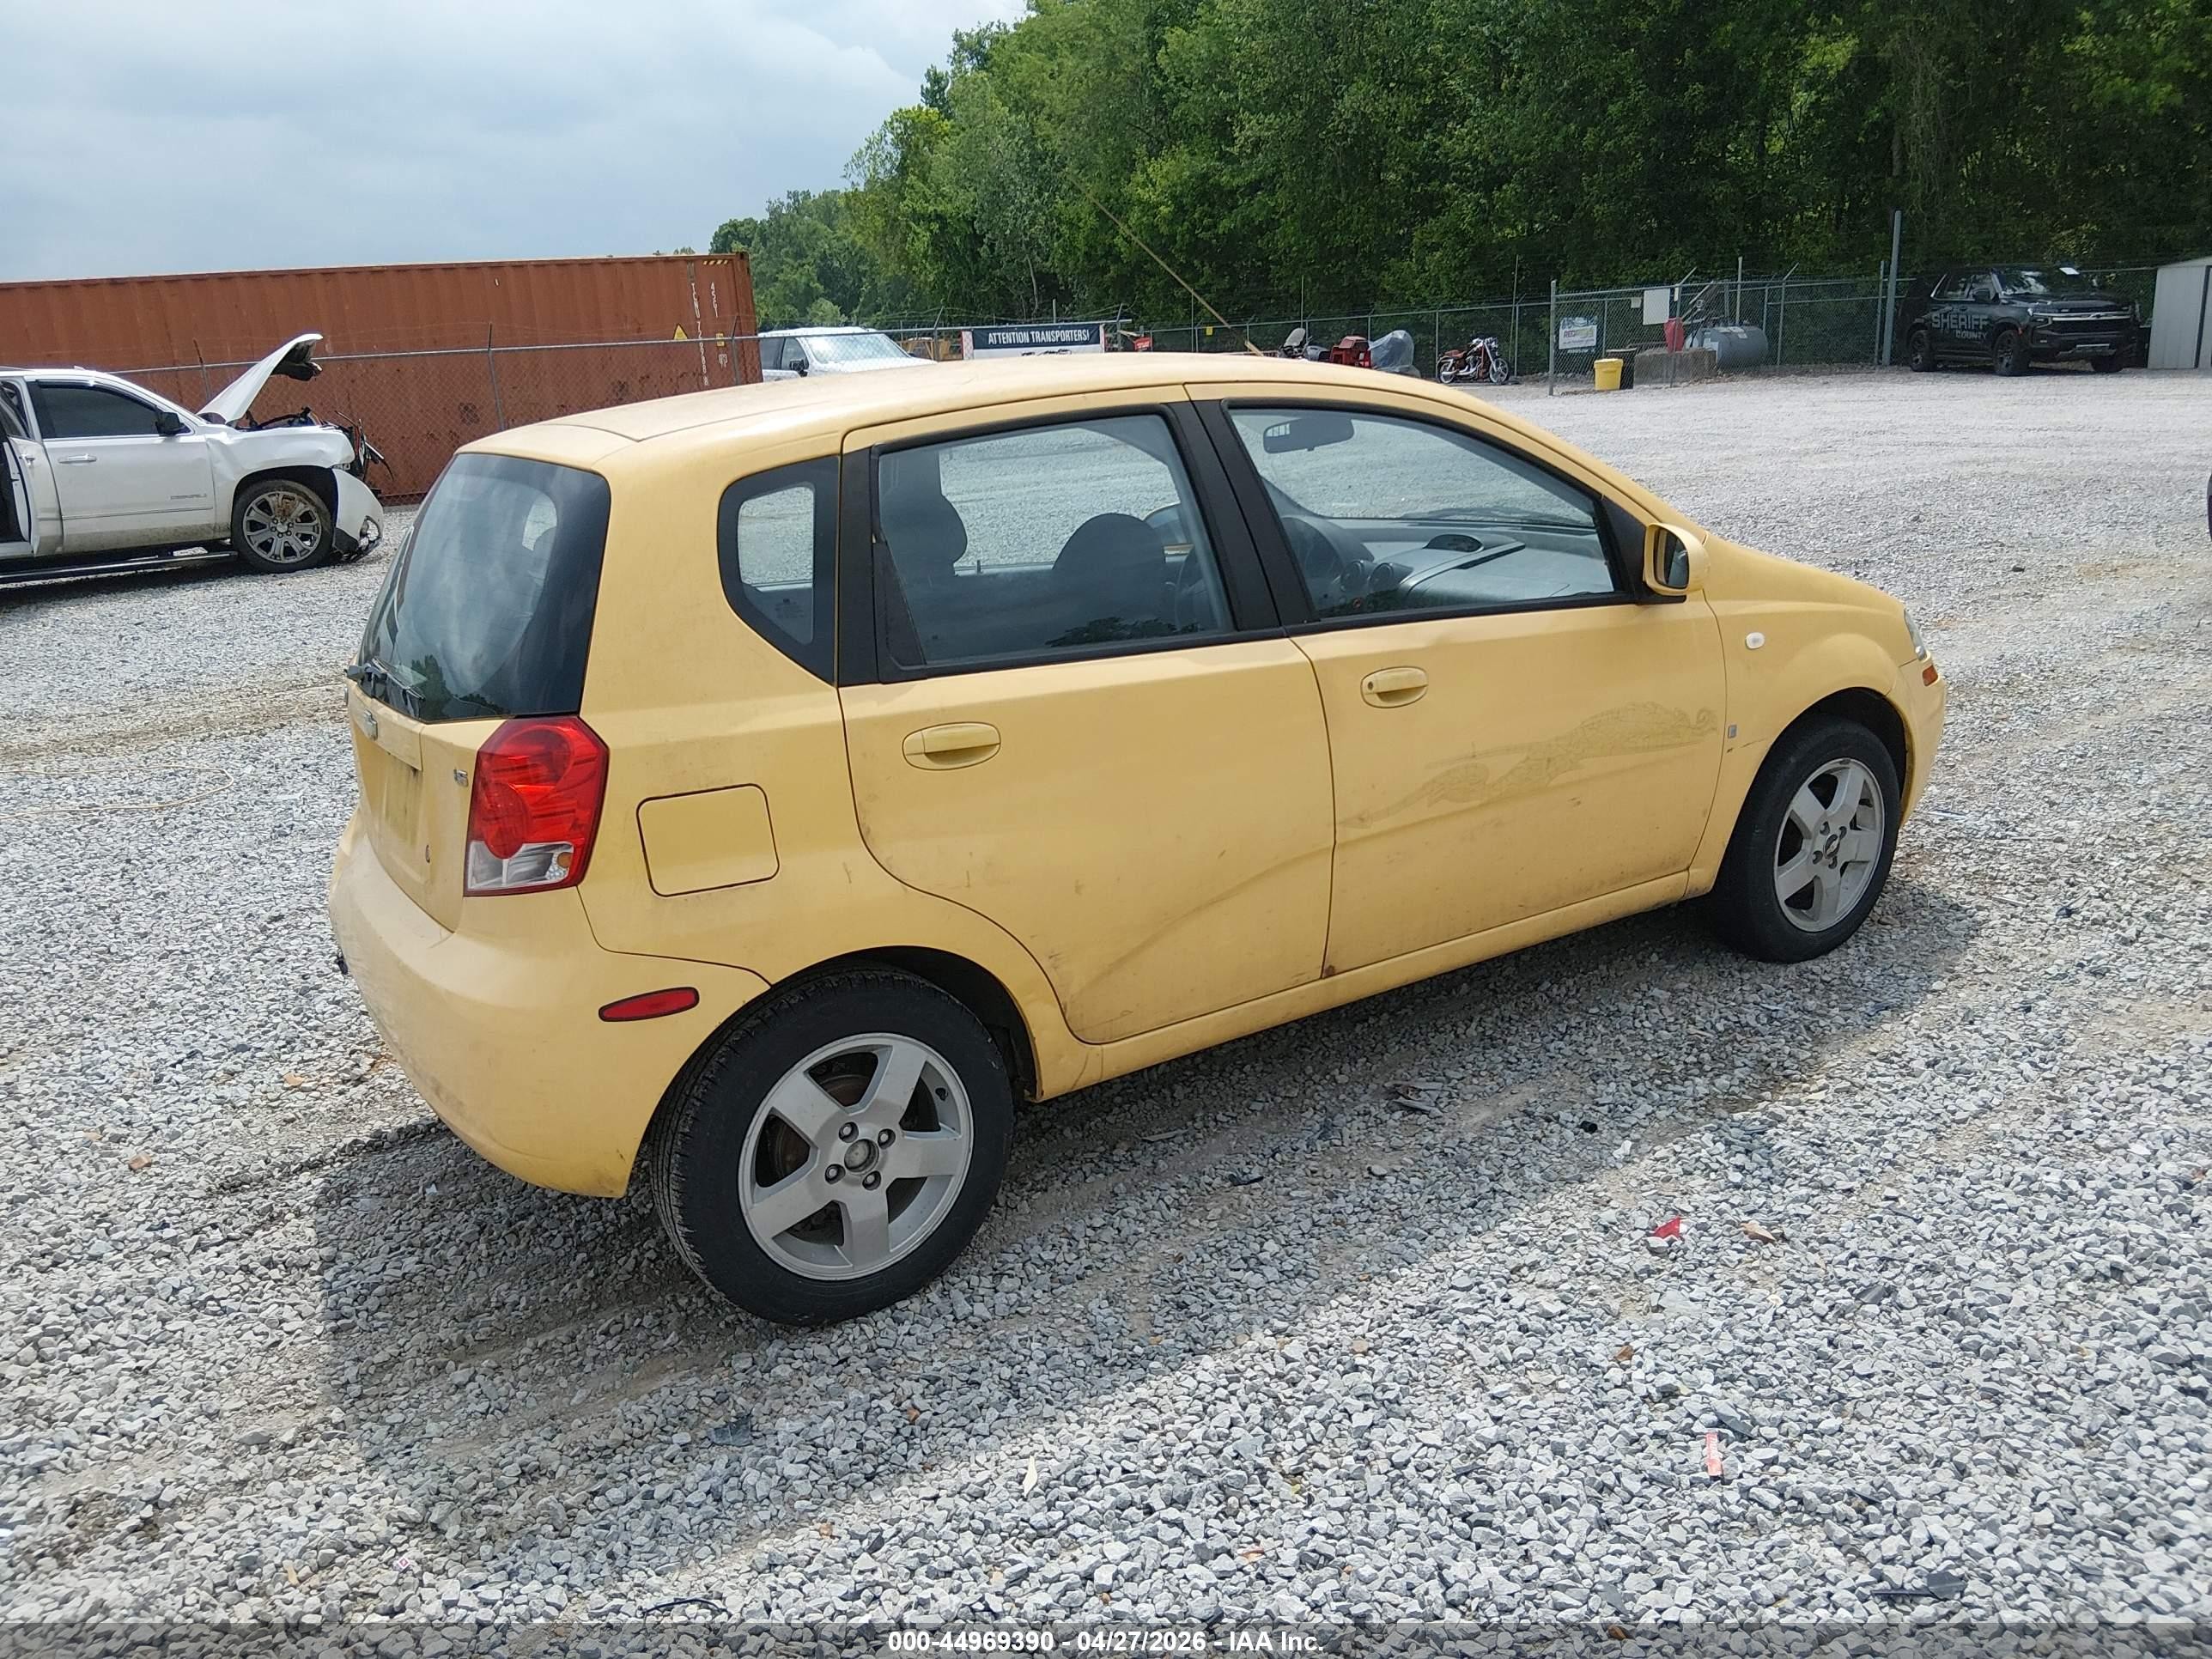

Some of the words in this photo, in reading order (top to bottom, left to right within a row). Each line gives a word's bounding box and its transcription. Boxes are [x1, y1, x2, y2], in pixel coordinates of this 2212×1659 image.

[1932, 313, 1989, 330] SHERIFF
[988, 331, 1030, 345] ATTENTION
[1030, 329, 1090, 343] TRANSPORTERS!
[1955, 330, 1987, 339] COUNTY
